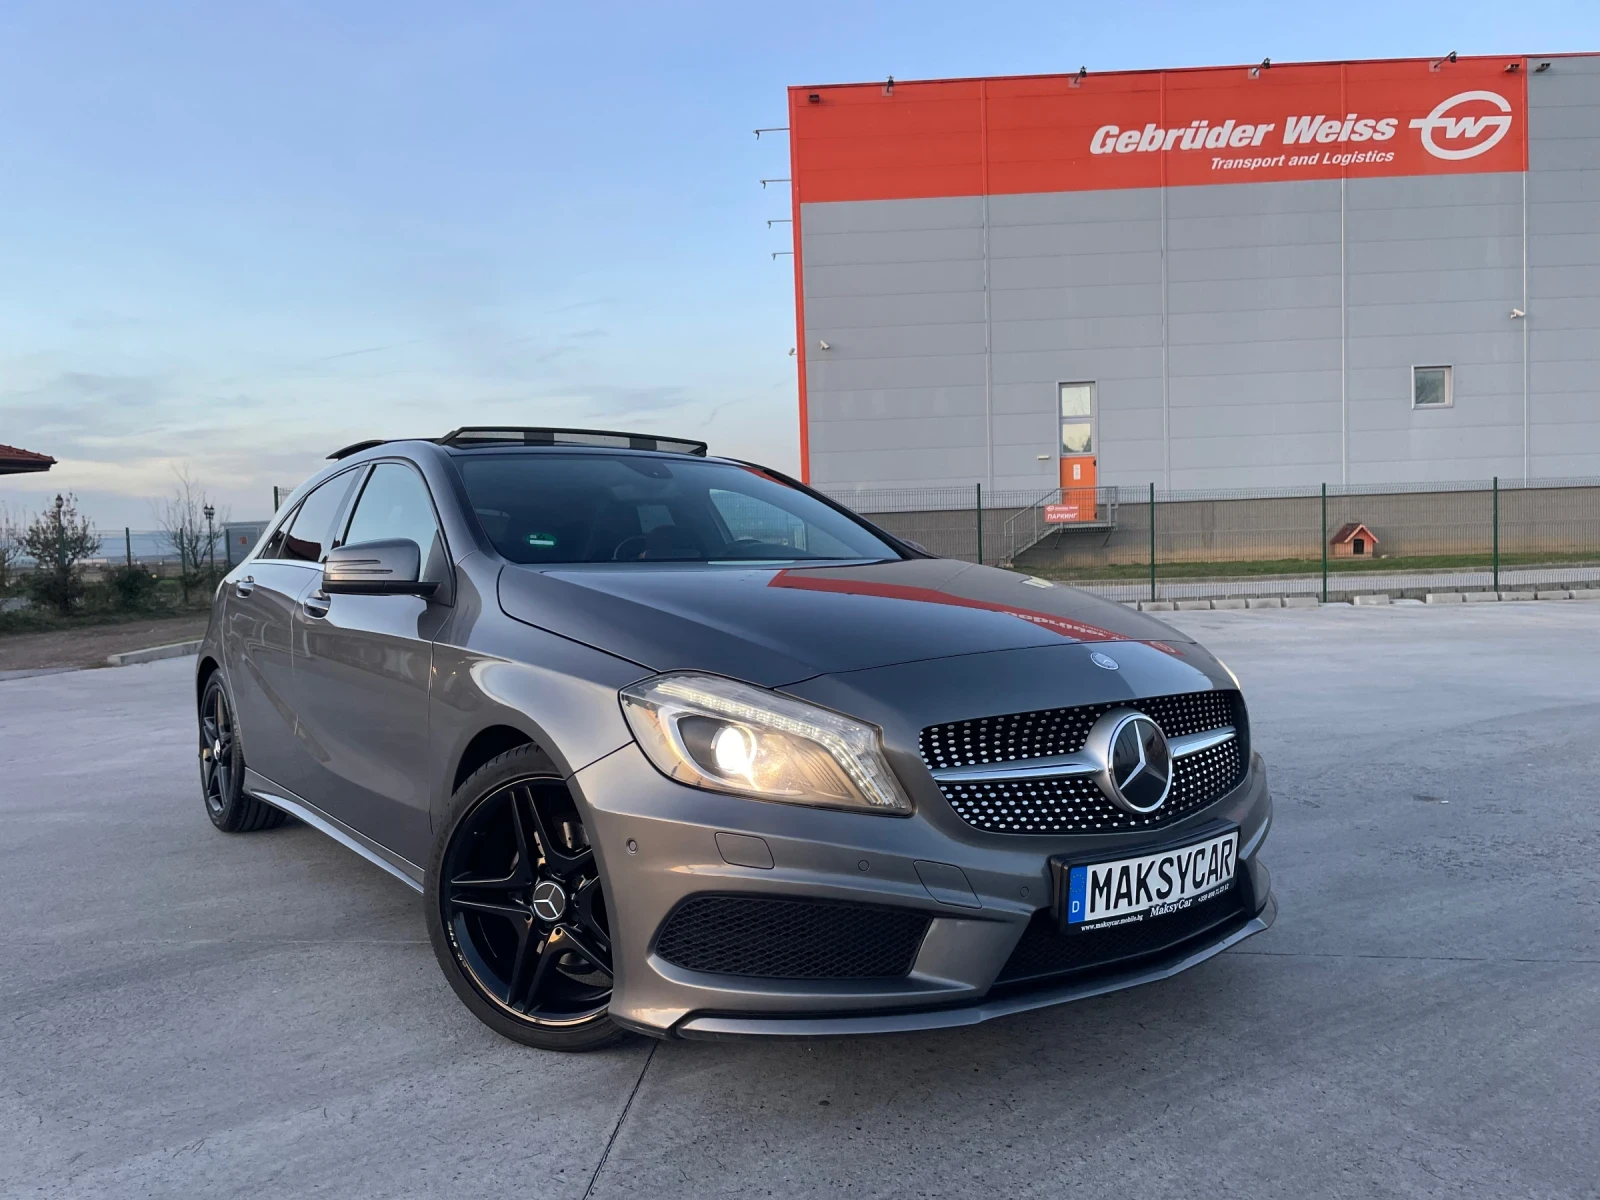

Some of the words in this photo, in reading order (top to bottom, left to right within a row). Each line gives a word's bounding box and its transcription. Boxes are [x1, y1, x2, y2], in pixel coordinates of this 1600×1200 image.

[1089, 119, 1275, 155] Gebrüder
[1282, 113, 1399, 145] Weiss
[1210, 154, 1285, 171] Transport
[1288, 153, 1319, 167] and
[1322, 150, 1395, 166] Logistics
[1089, 838, 1234, 914] MAKSYCAR
[1071, 900, 1080, 914] D
[1149, 898, 1193, 918] MaksyCar
[1080, 914, 1144, 932] www.maksycar.mobile.bg
